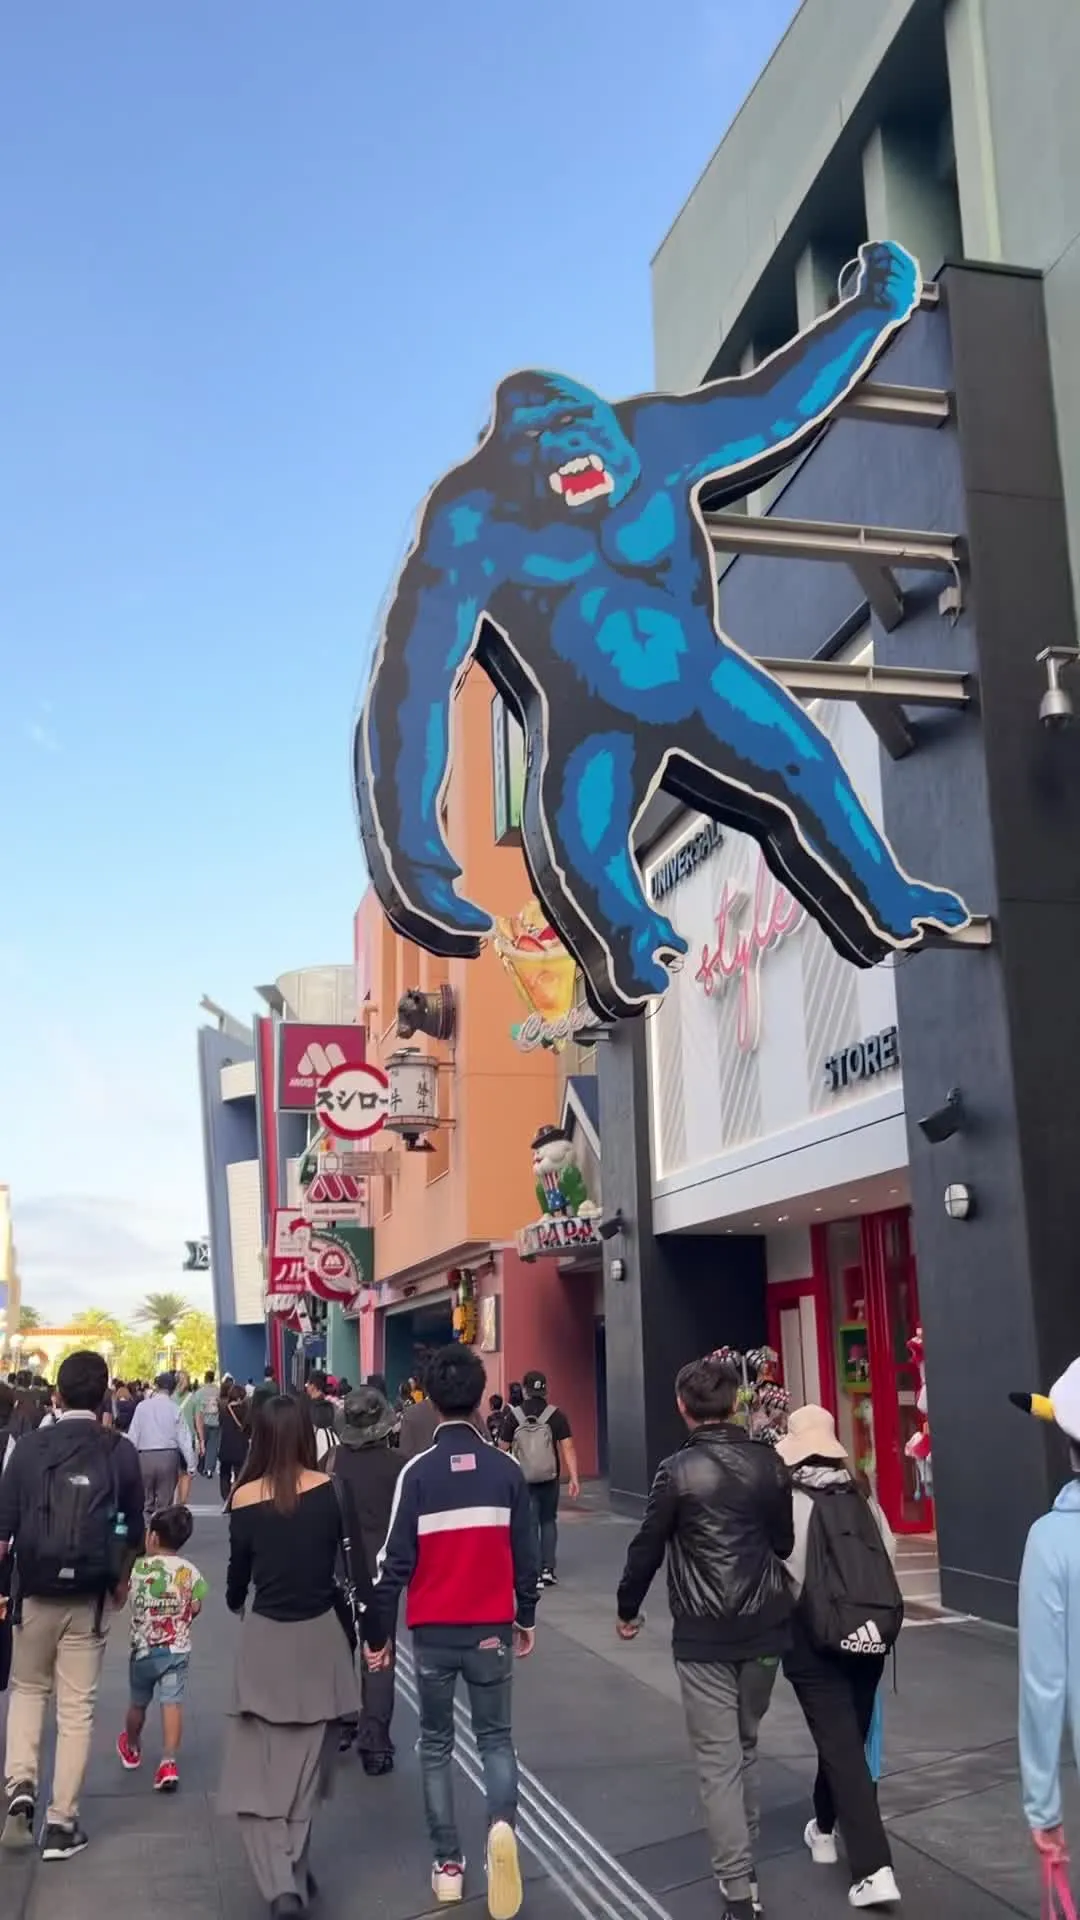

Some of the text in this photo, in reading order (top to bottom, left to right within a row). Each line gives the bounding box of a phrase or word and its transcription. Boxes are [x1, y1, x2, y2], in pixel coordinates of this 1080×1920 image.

[652, 820, 724, 900] UNIVERSAL
[694, 847, 798, 1055] style
[824, 1025, 900, 1092] STORE
[317, 1089, 389, 1112] スシロー
[840, 1639, 887, 1654] adidas
